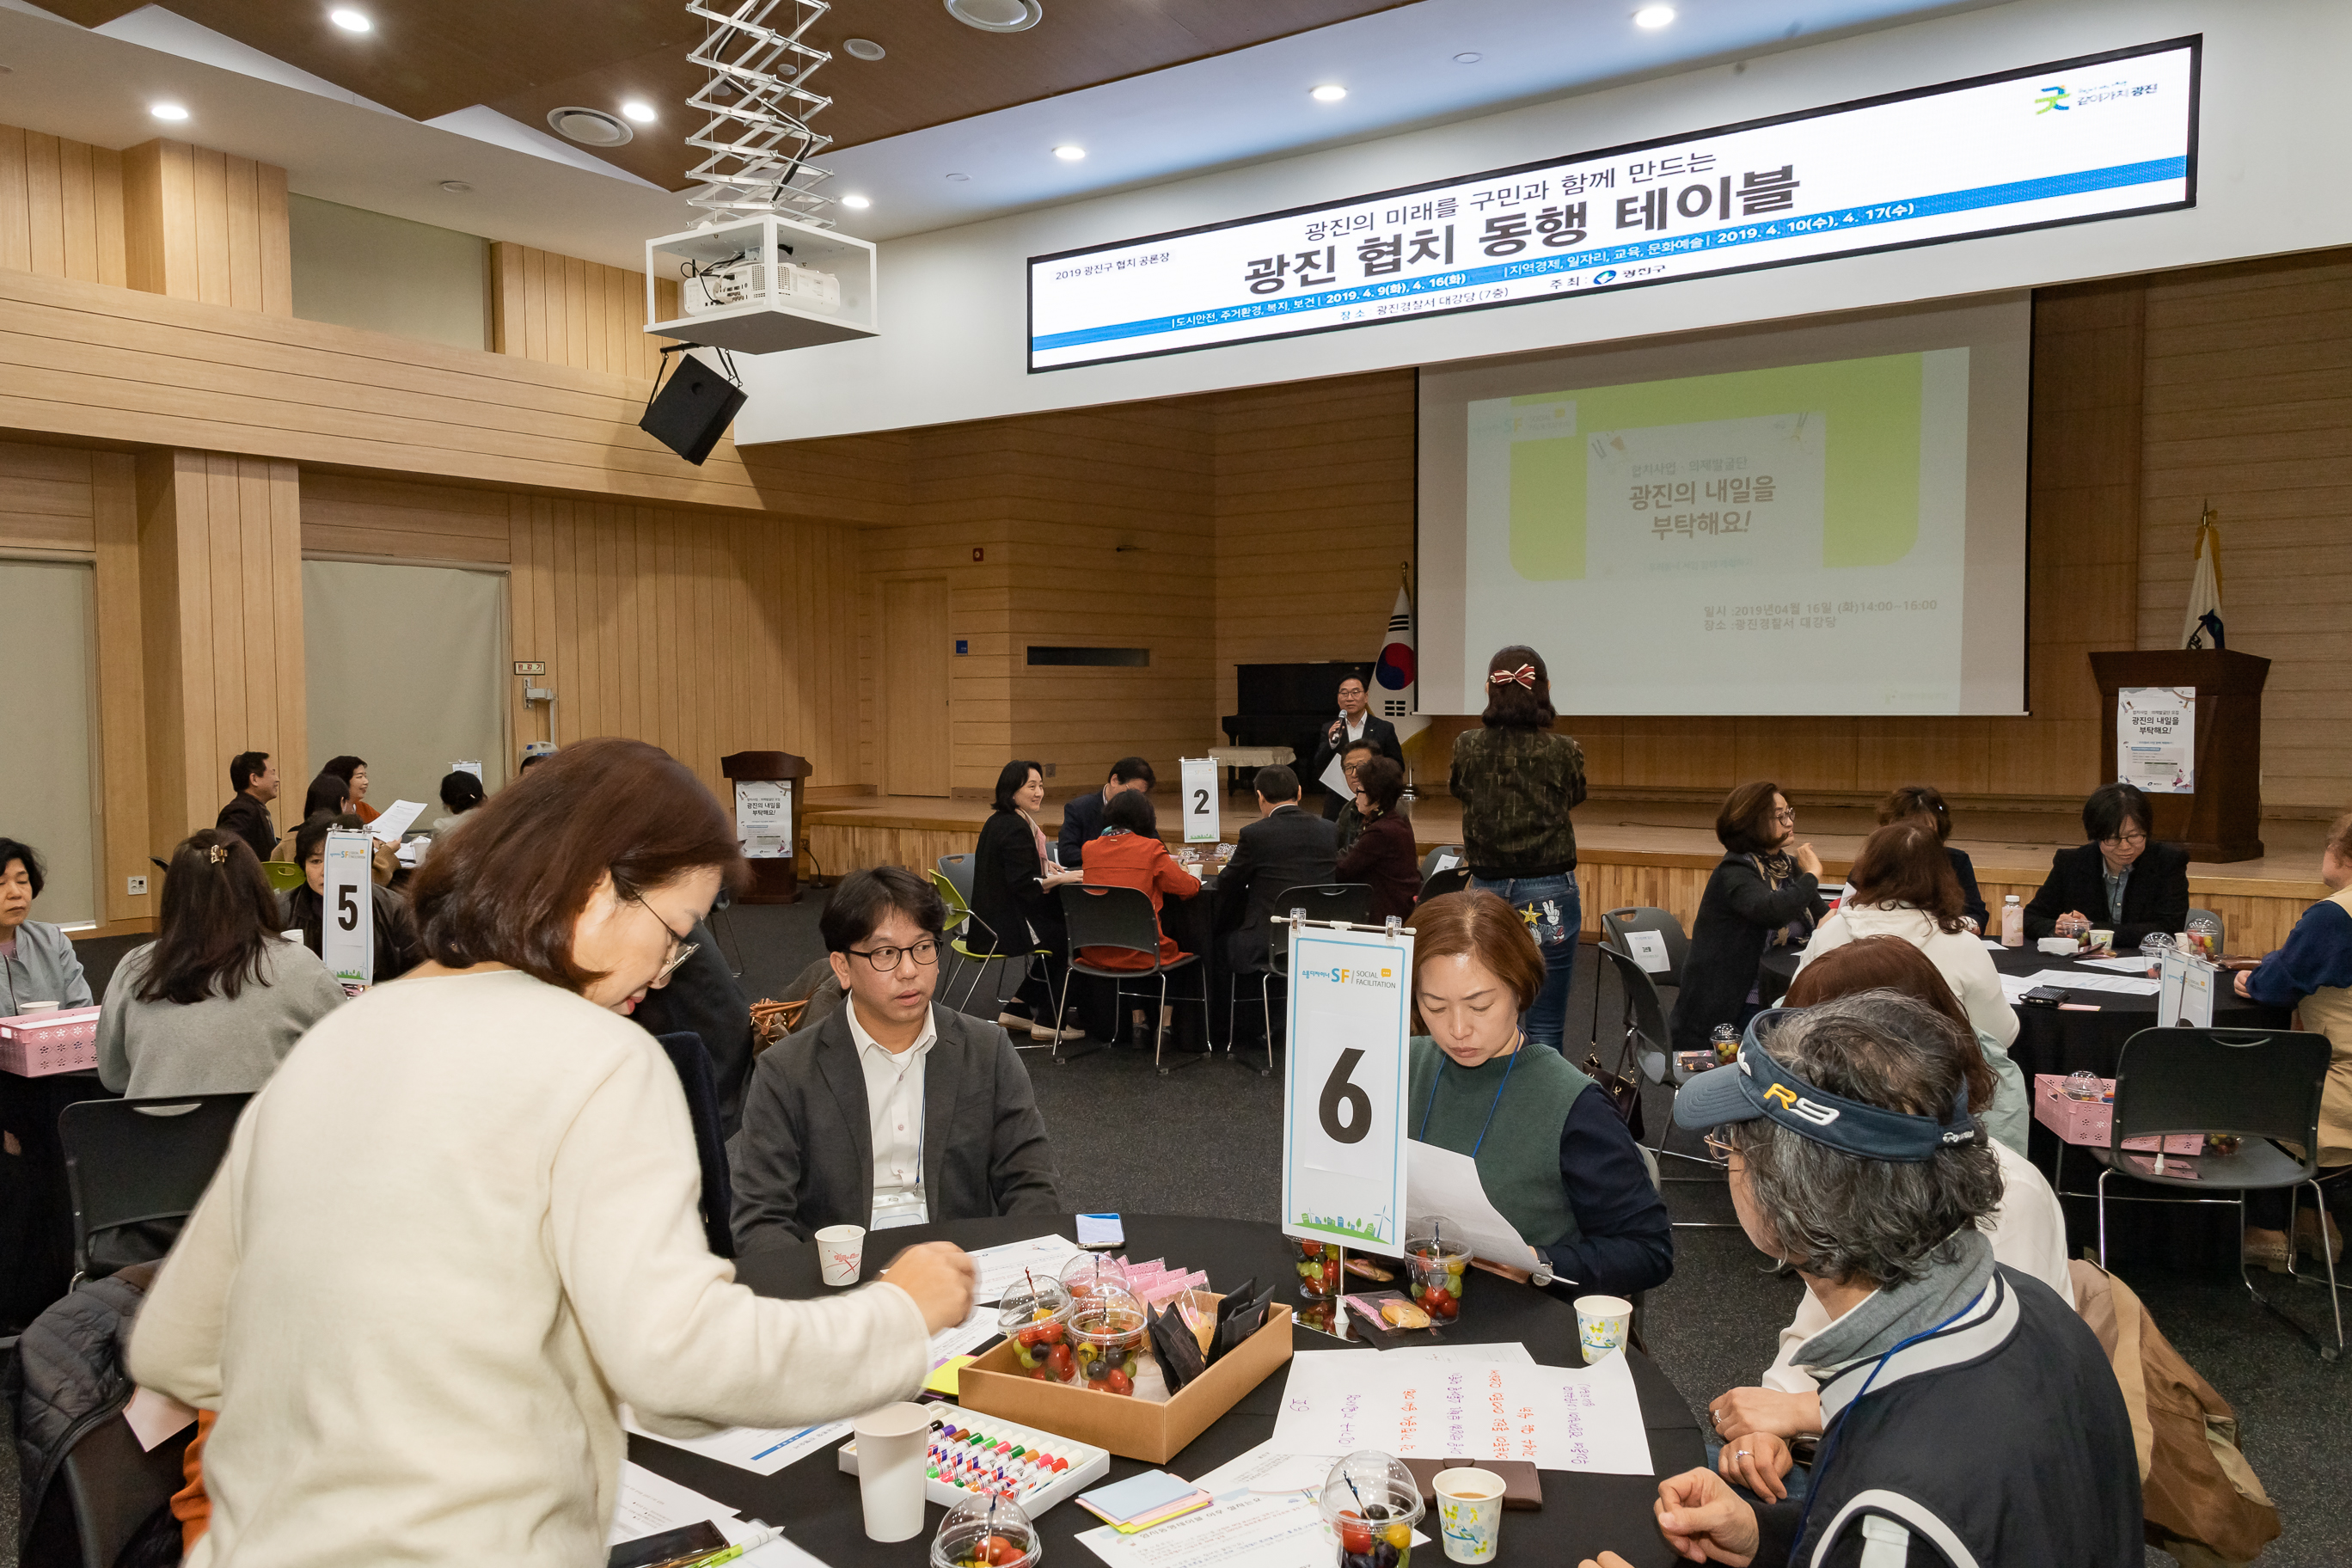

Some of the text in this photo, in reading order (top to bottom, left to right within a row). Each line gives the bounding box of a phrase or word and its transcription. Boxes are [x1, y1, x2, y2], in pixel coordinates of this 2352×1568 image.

[1305, 152, 1717, 240] 광진의 미래를 구민과 함께 만드는
[1245, 164, 1800, 294] 광진 협치 동행 테이블
[1056, 252, 1170, 280] 2019 광진구 협치 공론장
[1176, 203, 1914, 328] 도시안전, 주거환경, 복지, 보건 2019. 4. 9(화), 4. 16(화) 지역경제, 일자리, 교육, 문화예술 2019. 4. 10(수), 4. 17(수)
[1377, 297, 1436, 315] 광진경찰서
[1439, 292, 1475, 307] 대강당
[1479, 287, 1509, 301] (7층)
[1631, 456, 1748, 478] 협치사업 의제발굴단
[1629, 475, 1776, 511] 광진의 내일을
[1651, 510, 1752, 541] 부탁해요!
[1704, 605, 1726, 617] 일시
[1806, 601, 1832, 615] 16일
[1704, 619, 1726, 631] 장소
[1800, 616, 1837, 628] 대강당
[2132, 717, 2179, 726] 광진의 내일을
[2139, 726, 2171, 735] 부탁해요!
[1193, 789, 1210, 814] 2
[338, 885, 358, 931] 5
[1331, 968, 1350, 983] SF
[1356, 978, 1396, 989] FACILITATION
[1357, 970, 1378, 978] SOCIAL
[1319, 1047, 1372, 1144] 6
